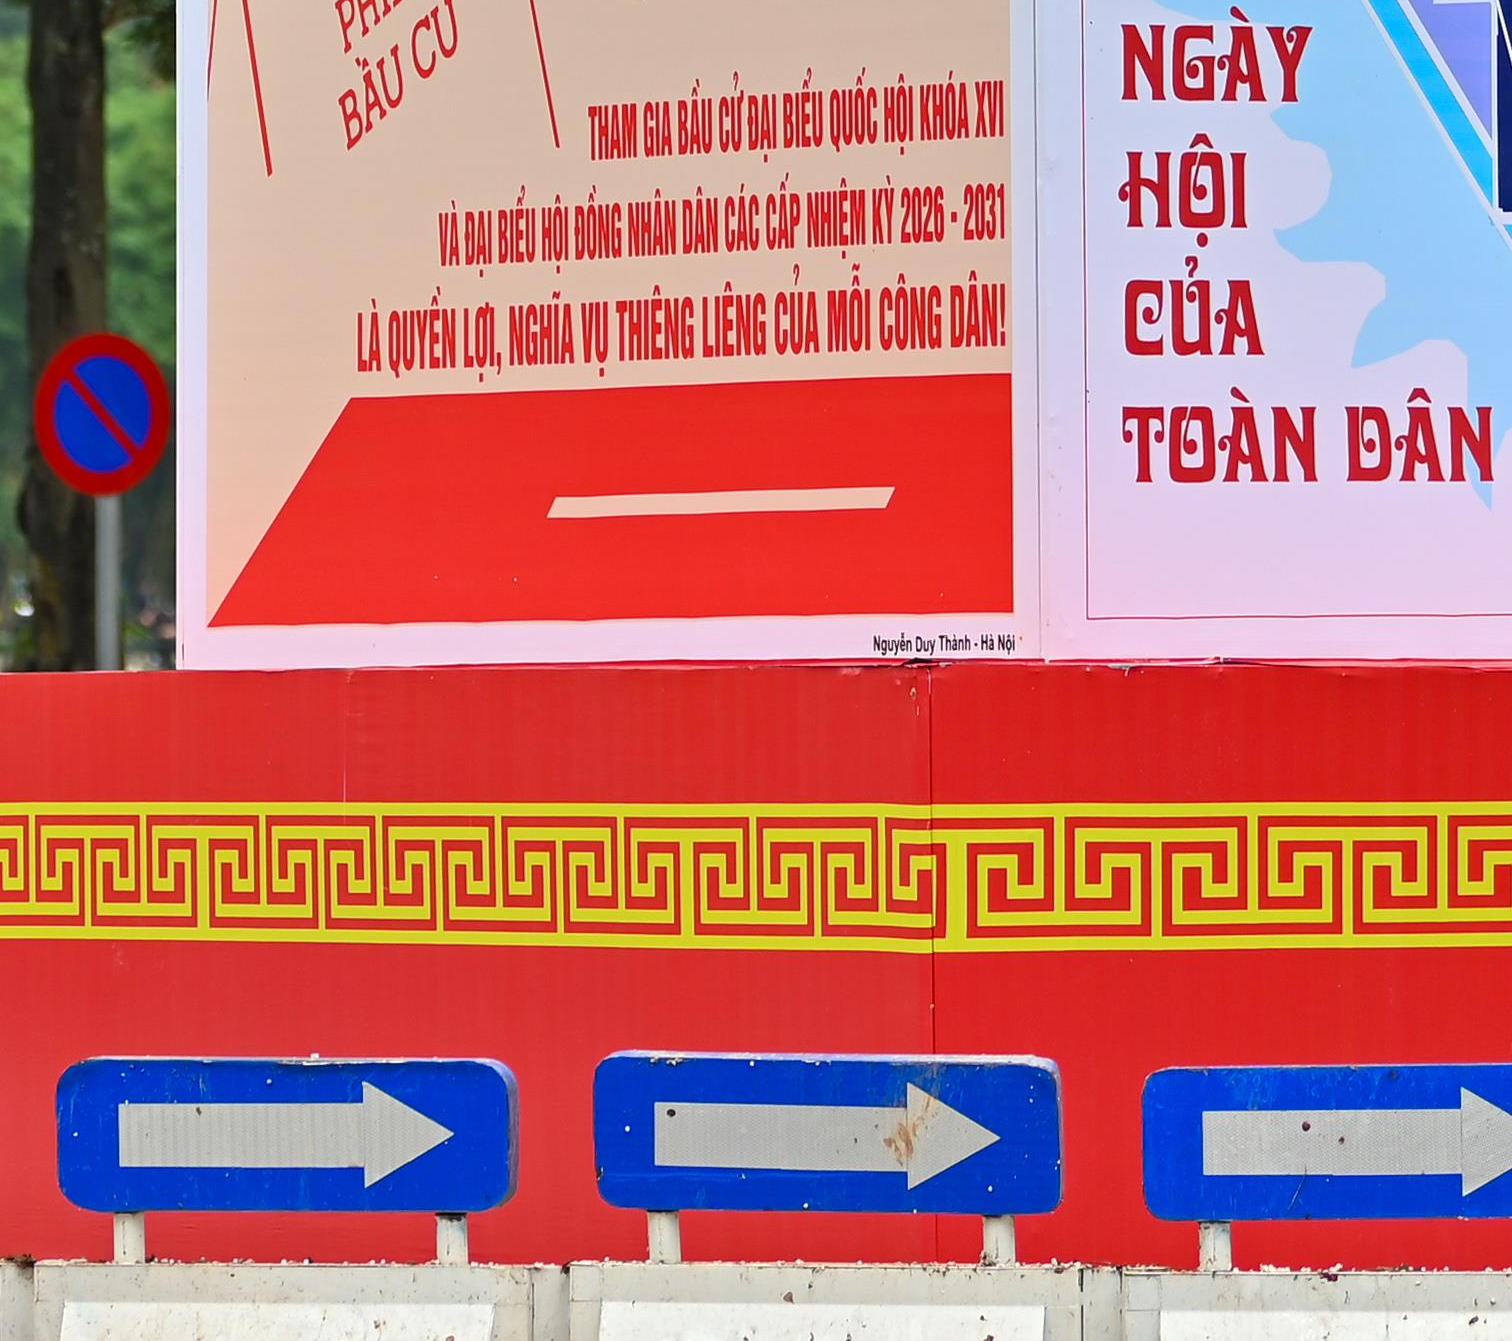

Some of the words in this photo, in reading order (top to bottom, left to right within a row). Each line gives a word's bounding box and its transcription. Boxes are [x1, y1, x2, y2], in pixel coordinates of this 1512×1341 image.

[338, 43, 404, 151] BẦU
[1120, 5, 1313, 103] NGÀY
[588, 103, 638, 161] THAM
[643, 99, 673, 158] GIA
[677, 78, 712, 155] BẦU
[718, 70, 744, 154] CỬ
[746, 92, 777, 163] ĐẠI
[782, 67, 824, 148] BIỂU
[829, 66, 877, 152] QUỐC
[882, 73, 913, 156] HỘI
[919, 69, 969, 143] KHÓA
[974, 80, 1005, 138] XVI
[438, 199, 460, 267] VÀ
[464, 208, 492, 278] ĐẠI
[497, 183, 536, 263] BIỂU
[540, 193, 569, 274] HỘI
[574, 183, 622, 261] ĐỒNG
[627, 188, 677, 257] NHÂN
[681, 185, 719, 255] DÂN
[723, 183, 760, 252] CÁC
[765, 172, 801, 251] CẤP
[806, 176, 866, 259] NHIỆM
[872, 174, 896, 246] KỲ
[900, 184, 945, 244] 2026
[962, 182, 1006, 241] 2031
[1117, 132, 1248, 248] HỘI
[356, 297, 382, 372] LÀ
[387, 286, 457, 379] QUYỀN
[463, 301, 502, 382] LỢI,
[508, 289, 575, 367] NGHĨA
[581, 298, 609, 377] VỤ
[616, 284, 694, 363] THIÊNG
[701, 280, 766, 358] LIÊNG
[774, 263, 819, 354] CỦA
[826, 263, 871, 353] MỖI
[878, 272, 942, 351] CÔNG
[950, 269, 1006, 348] DÂN!
[1123, 255, 1265, 356] CỦA
[1121, 385, 1318, 484] TOÀN
[1344, 387, 1495, 483] DÂN
[873, 632, 912, 656] Nguyễn
[915, 636, 936, 656] Duy
[938, 634, 971, 652] Thành
[980, 634, 994, 651] Hà
[997, 634, 1015, 655] Nội
